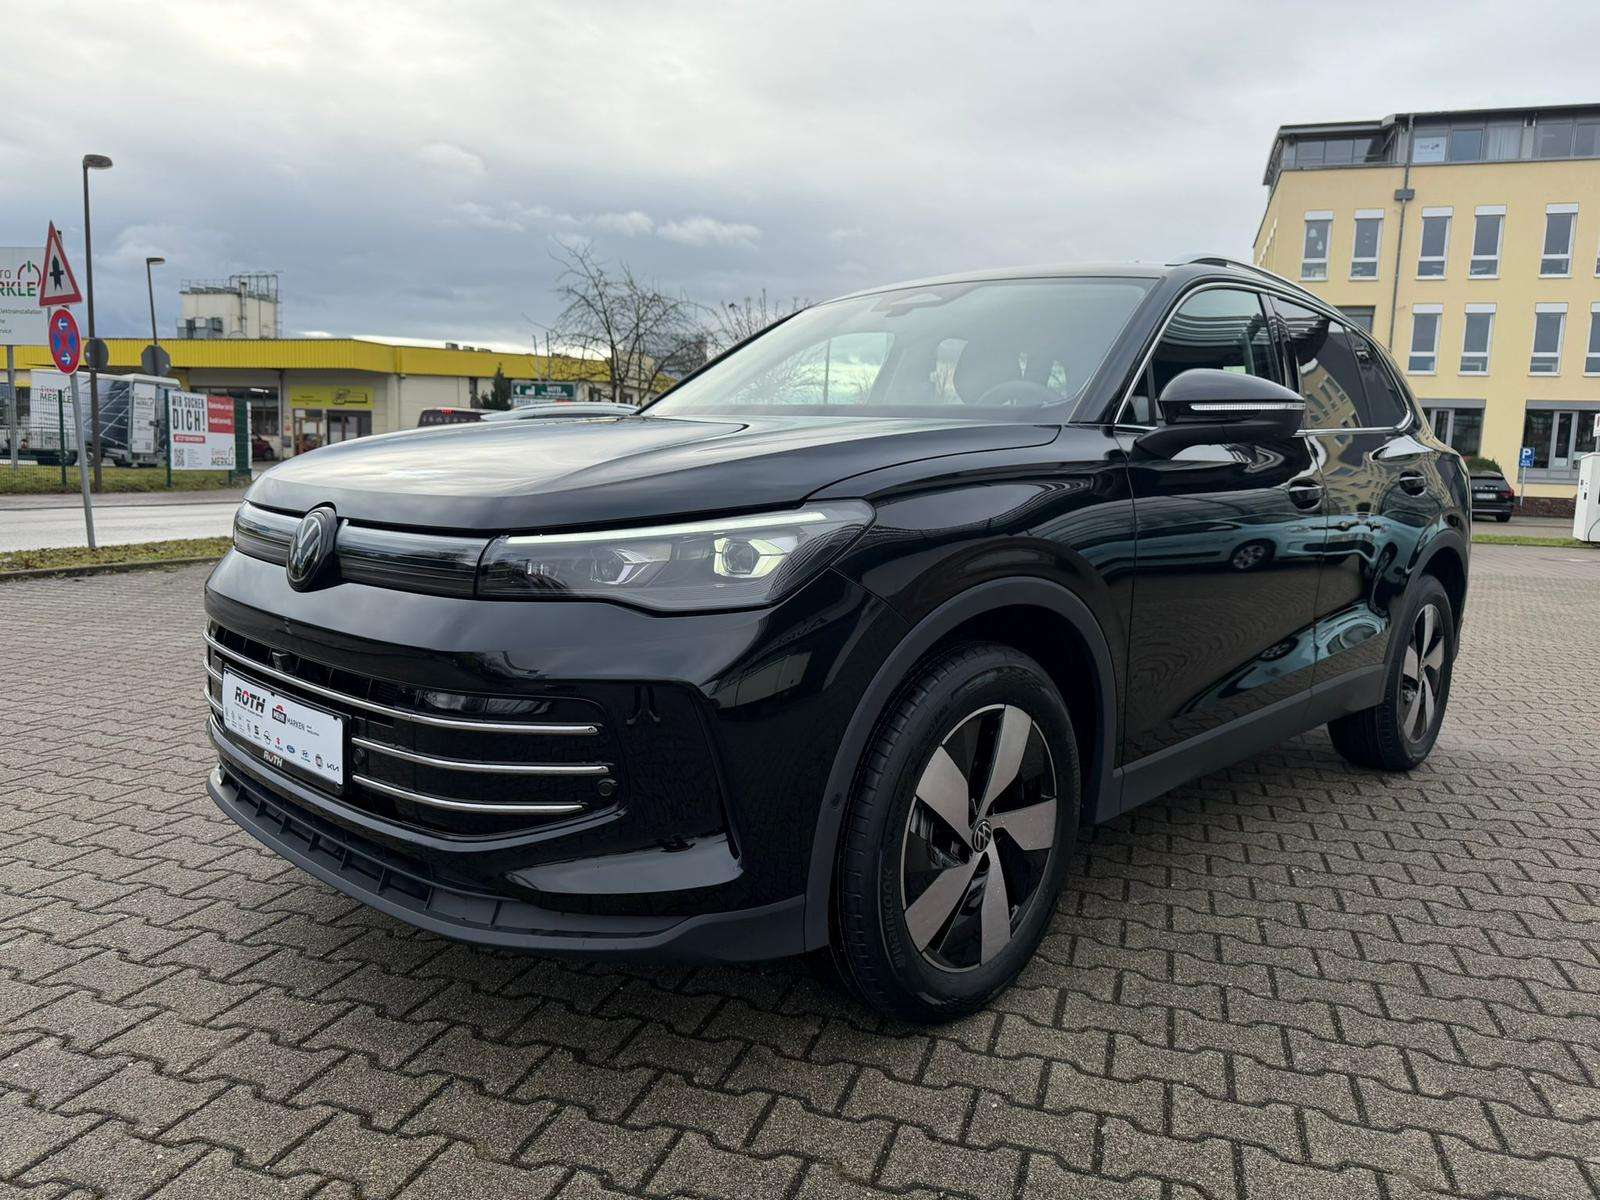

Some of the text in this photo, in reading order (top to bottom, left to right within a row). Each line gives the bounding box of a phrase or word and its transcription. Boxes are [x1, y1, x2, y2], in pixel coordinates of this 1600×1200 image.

[41, 393, 73, 404] MERLE
[172, 395, 182, 407] WIR
[184, 397, 204, 409] SUCHEN
[172, 408, 206, 432] DICH!
[1522, 448, 1532, 459] P
[234, 686, 266, 713] ROTH
[263, 750, 283, 767] ROTH
